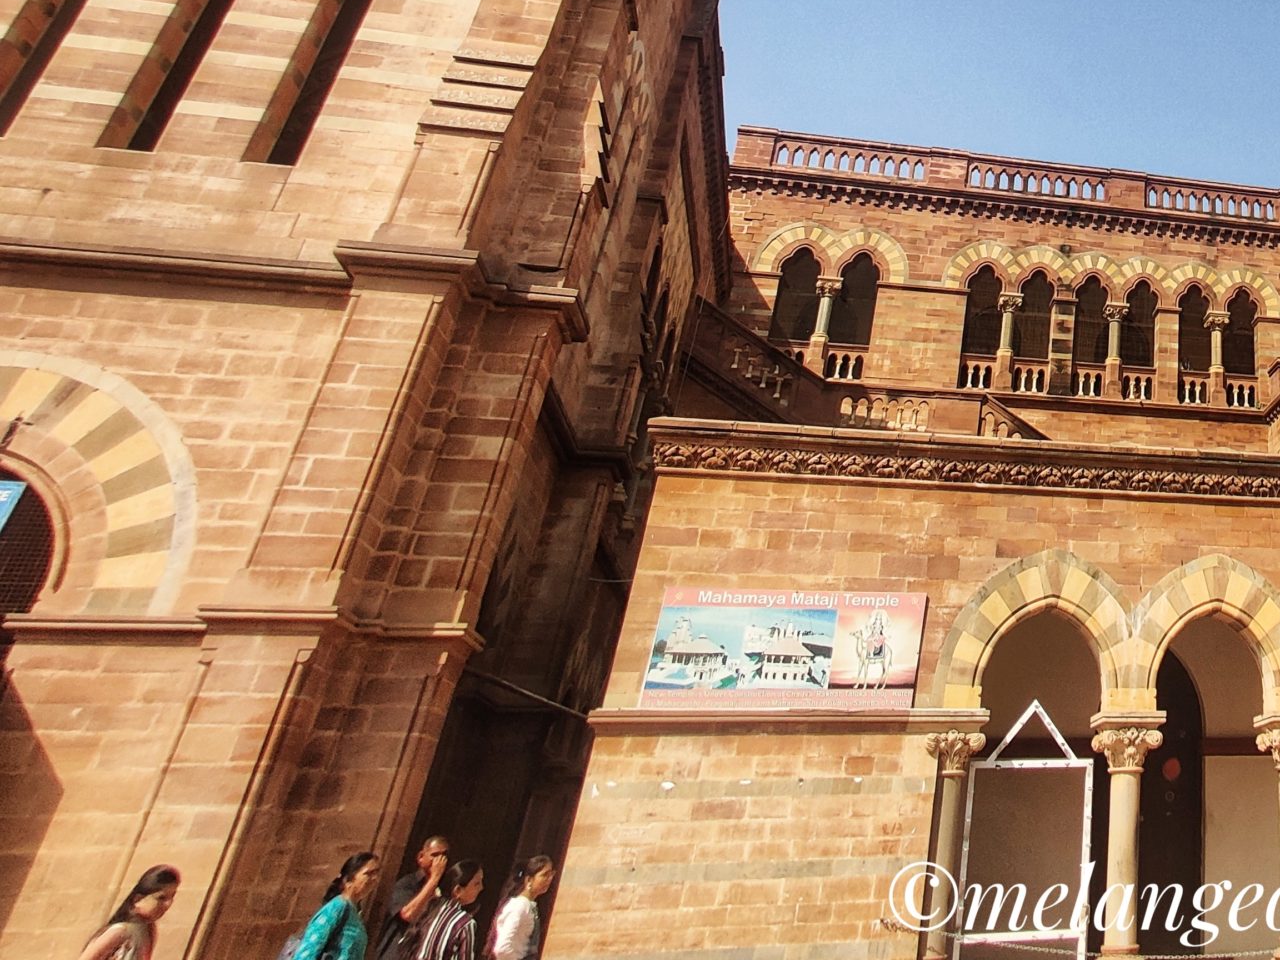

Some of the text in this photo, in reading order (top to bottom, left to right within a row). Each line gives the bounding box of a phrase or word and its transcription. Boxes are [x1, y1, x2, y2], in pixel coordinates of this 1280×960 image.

[698, 591, 900, 608] Mahamaya Mataji Temple
